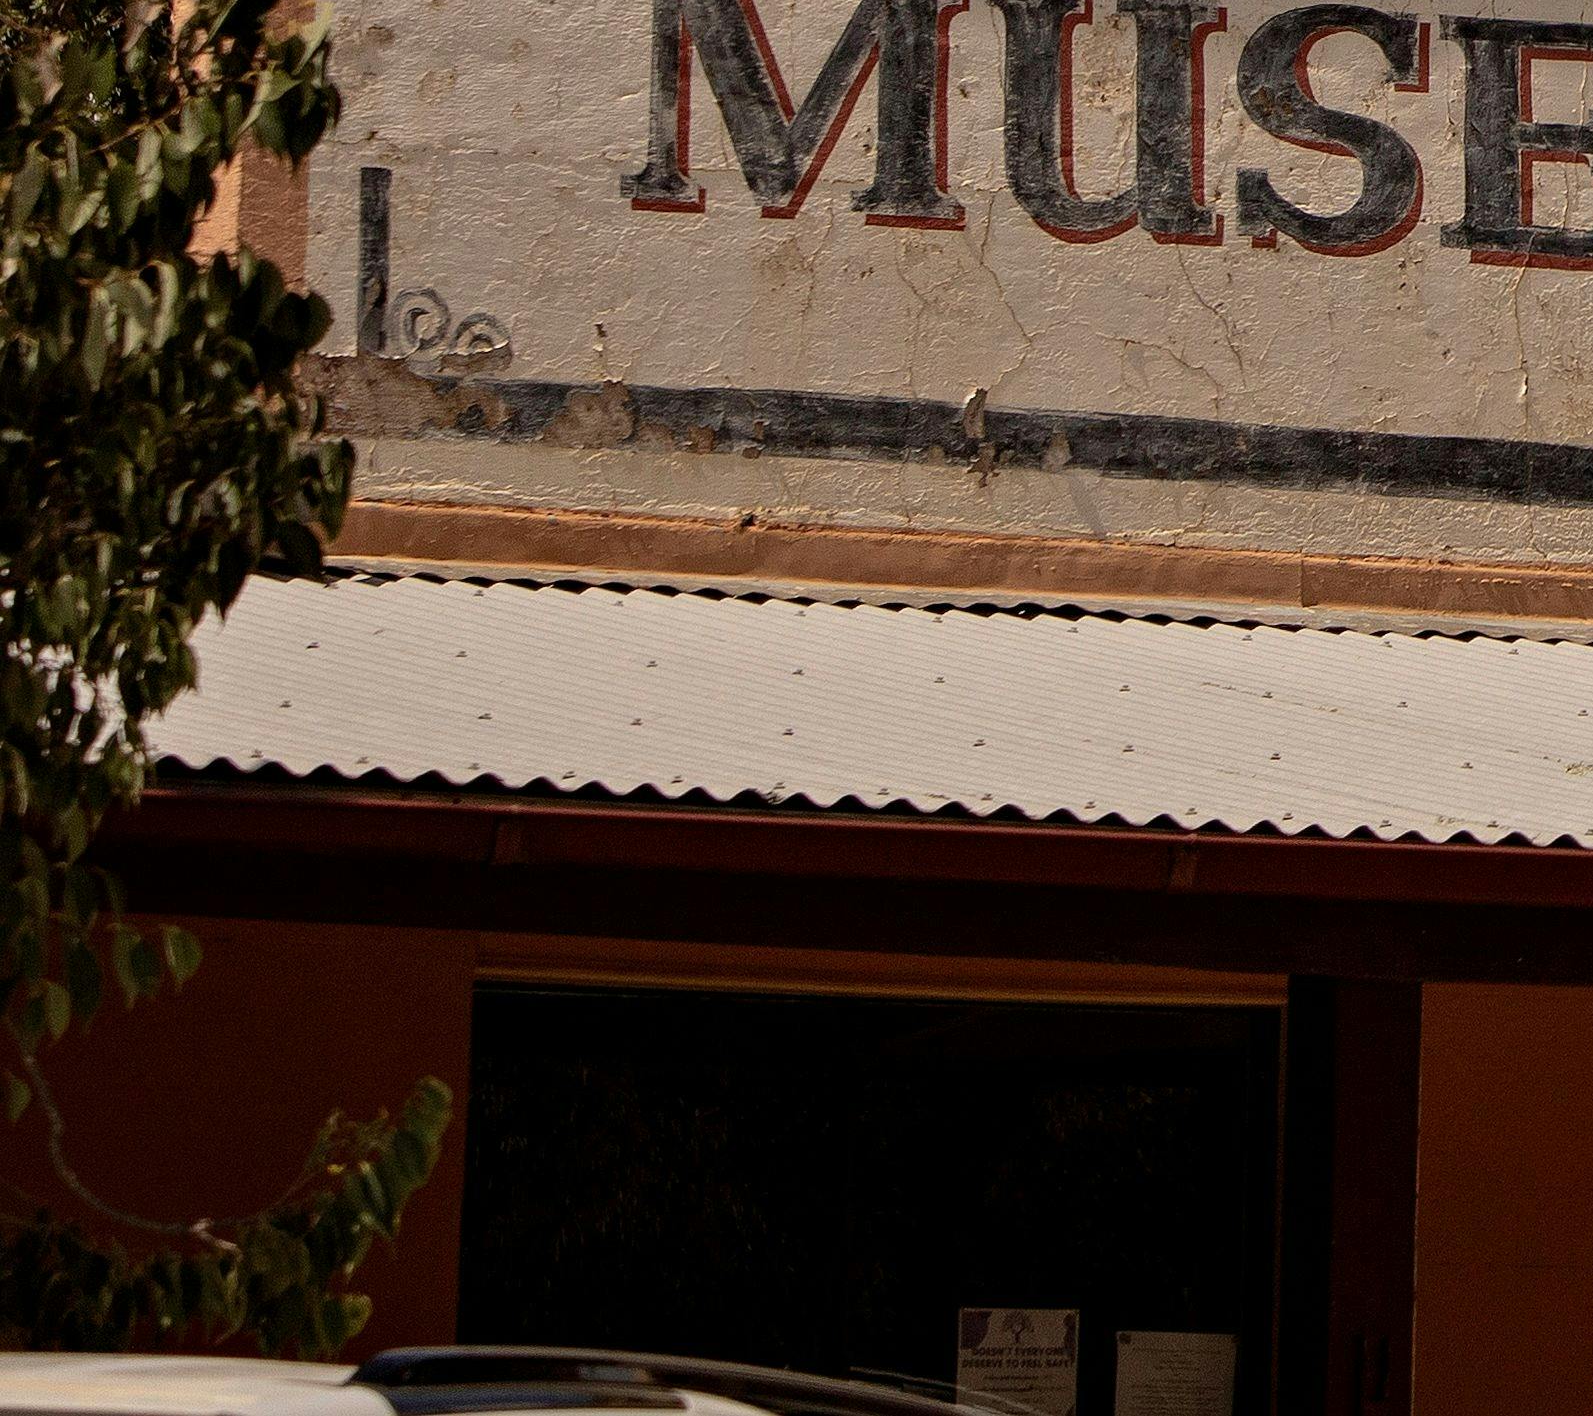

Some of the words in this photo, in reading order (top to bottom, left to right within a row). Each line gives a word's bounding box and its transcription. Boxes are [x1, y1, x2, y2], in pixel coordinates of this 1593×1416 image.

[961, 1358, 1003, 1368] DESERVE
[1006, 1358, 1020, 1368] TO
[1021, 1358, 1043, 1368] FEEL
